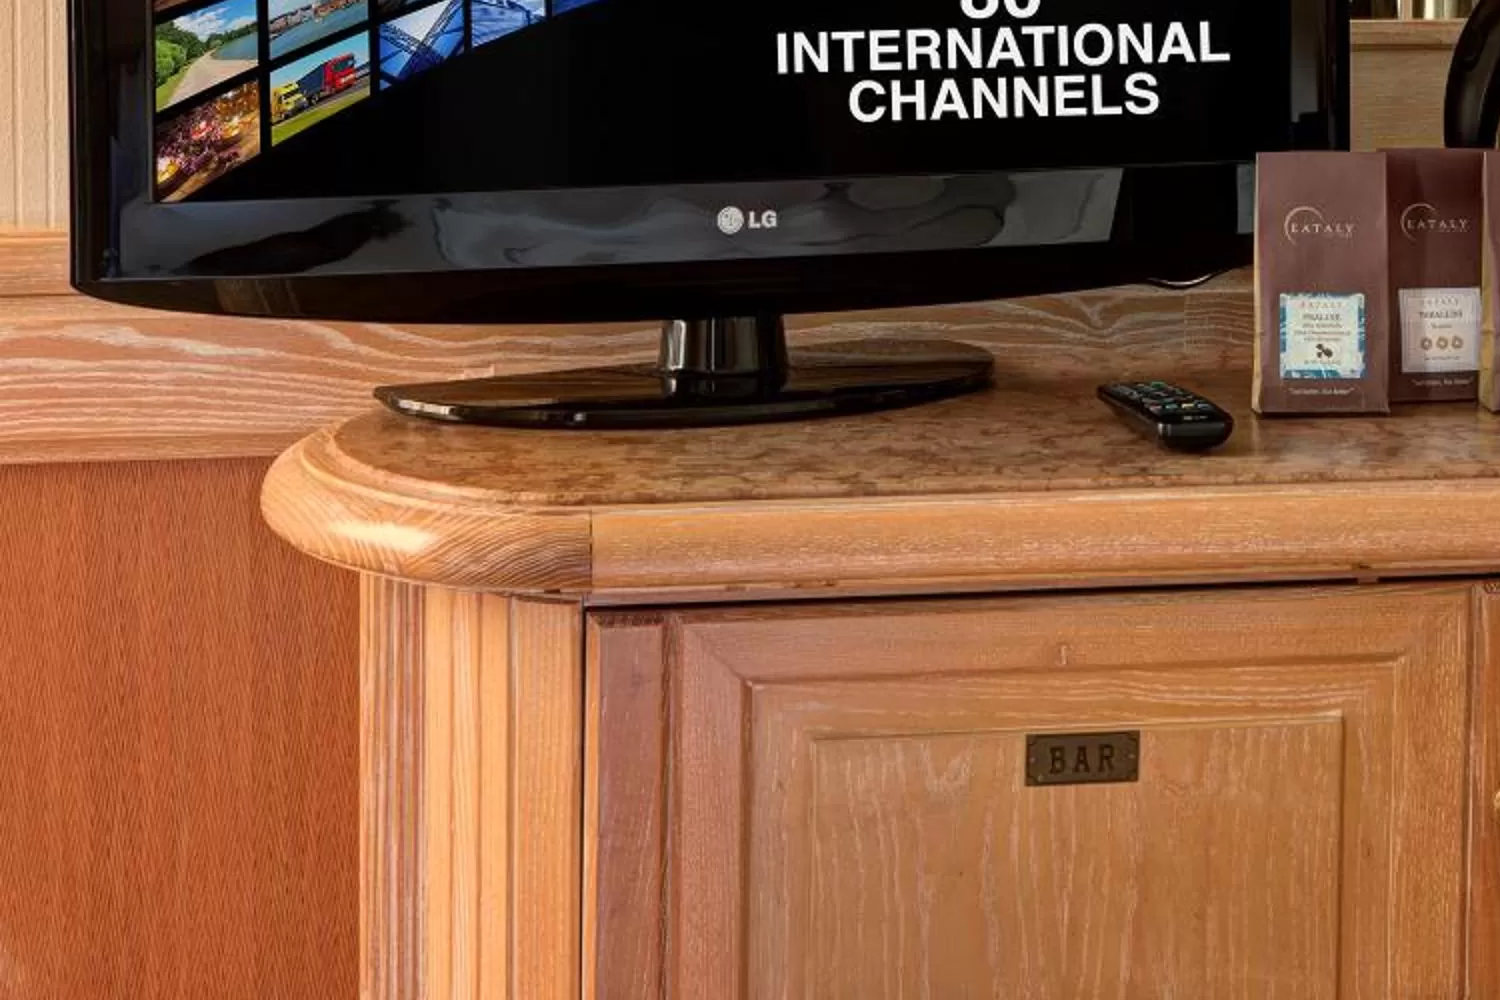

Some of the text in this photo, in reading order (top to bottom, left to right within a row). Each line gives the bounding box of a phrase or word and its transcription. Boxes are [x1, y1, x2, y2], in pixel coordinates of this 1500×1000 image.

[776, 20, 1231, 75] INTERNATIONAL
[848, 71, 1160, 123] CHANNELS
[748, 210, 778, 229] LG
[1290, 222, 1356, 233] EATALY
[1407, 218, 1470, 230] EATALY
[1048, 743, 1116, 775] BAR
